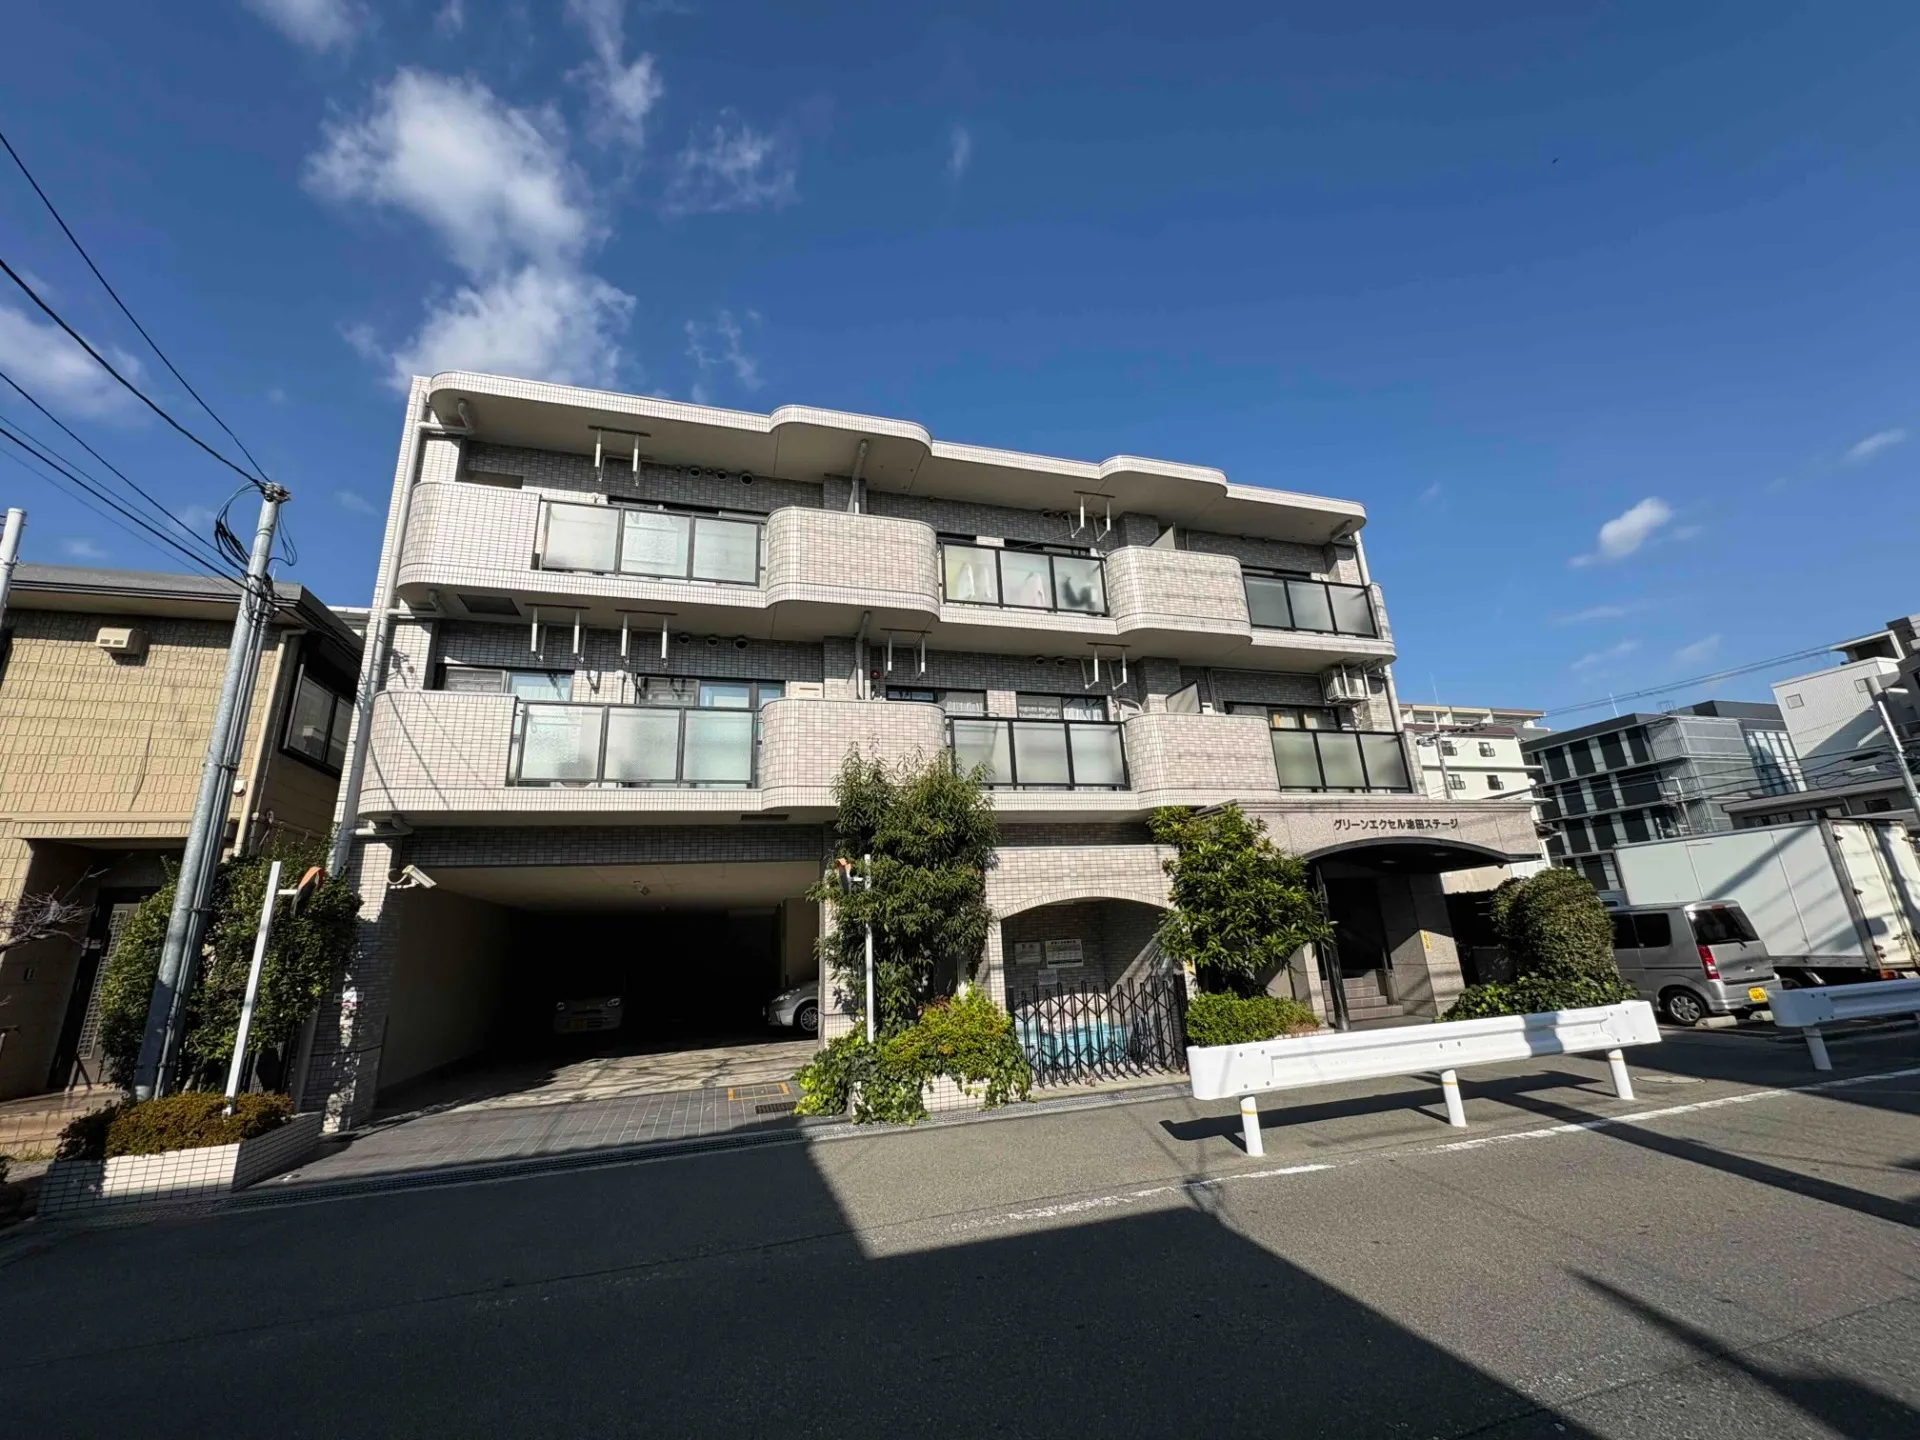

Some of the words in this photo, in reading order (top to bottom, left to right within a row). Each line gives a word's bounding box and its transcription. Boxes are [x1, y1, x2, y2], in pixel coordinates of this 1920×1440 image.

[1333, 818, 1458, 831] グリーンエクセル池田ステージ
